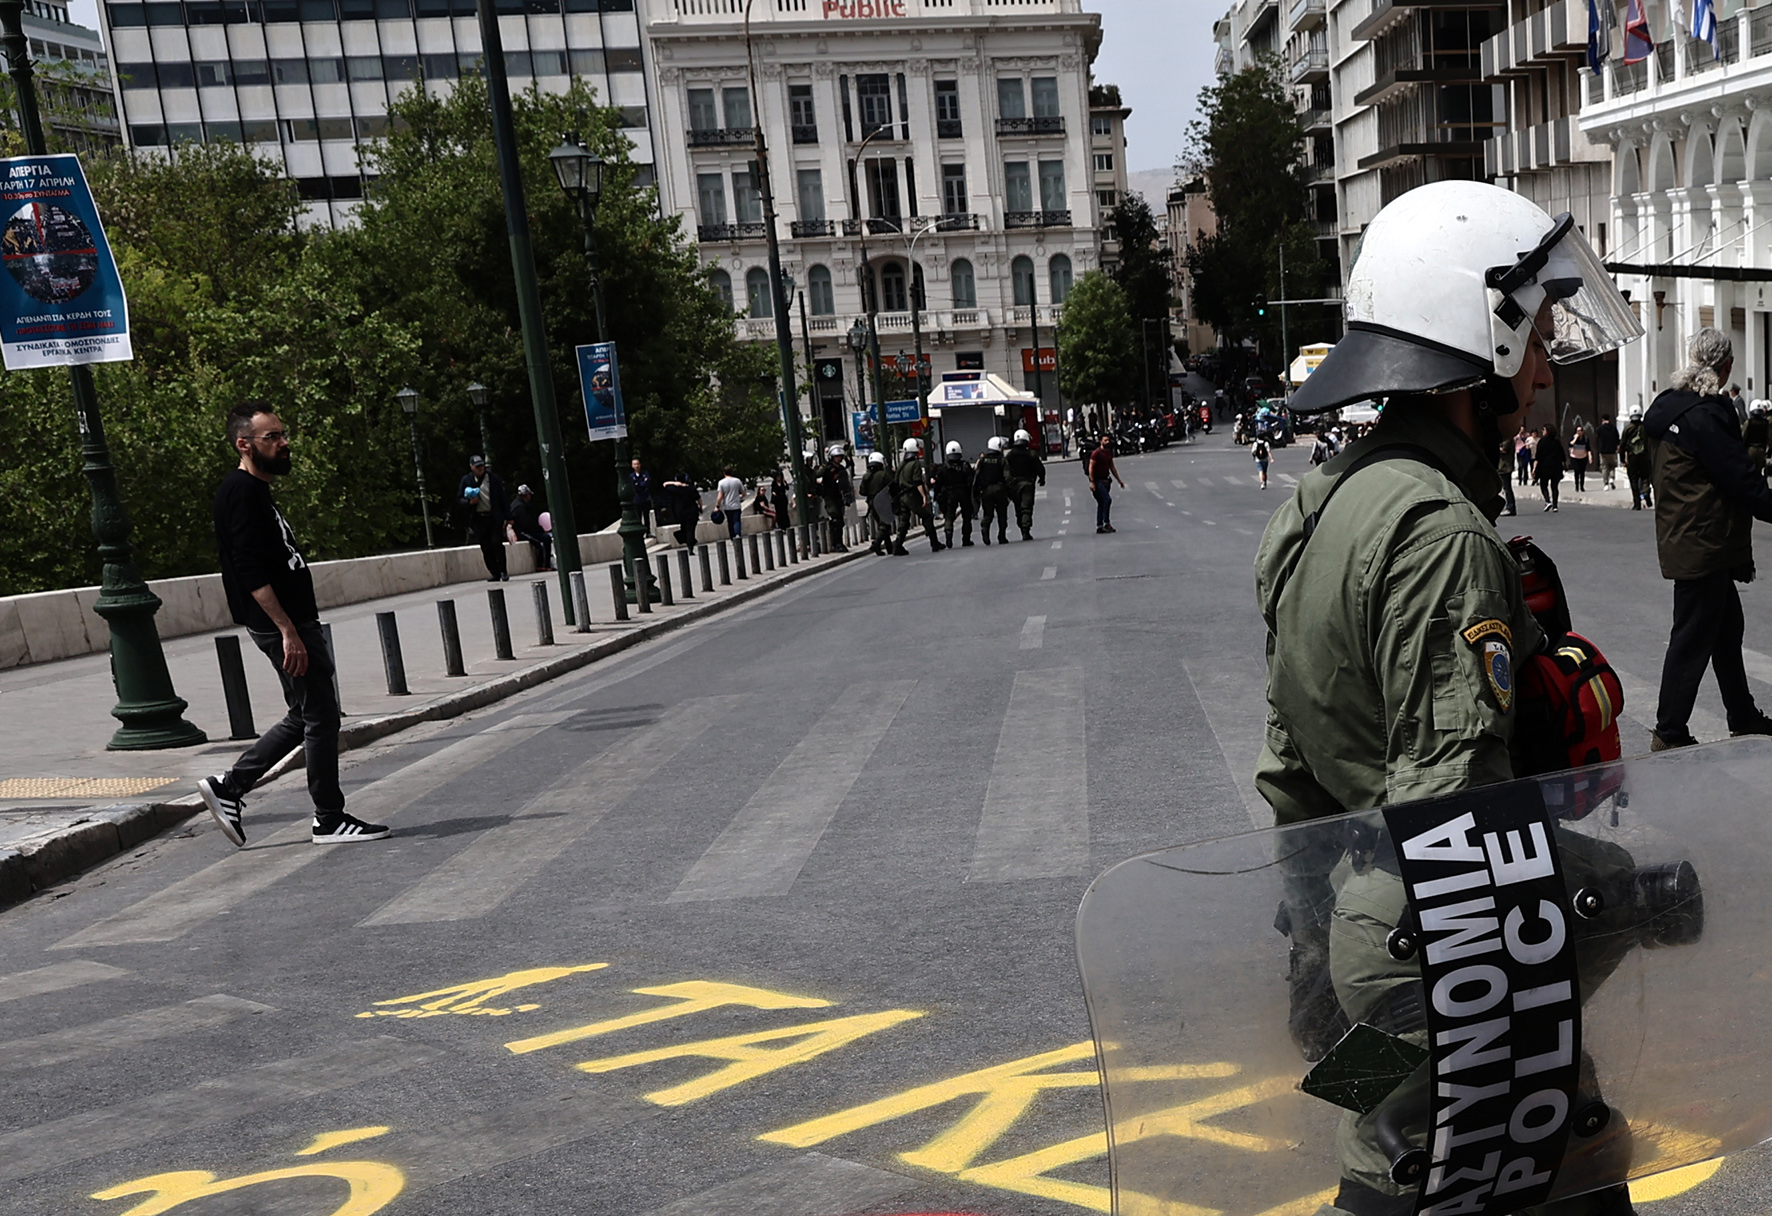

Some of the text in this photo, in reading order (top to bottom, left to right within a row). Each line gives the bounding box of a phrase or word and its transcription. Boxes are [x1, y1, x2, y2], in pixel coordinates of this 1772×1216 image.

[822, 0, 906, 19] Public
[9, 165, 52, 178] ΑΠΕΡΓΙΑ
[24, 179, 36, 189] 17
[40, 177, 75, 187] ΑΠΡΙΛΗ
[66, 312, 92, 320] ΚΕΡΔΗ
[93, 309, 112, 318] ΤΟΥΣ
[65, 337, 119, 348] ΟΜΟΣΠΟΝΔΙΕΣ
[74, 346, 103, 355] ΚΕΝΤΡΑ
[1483, 821, 1574, 1198] POLICE
[505, 979, 930, 1107] ΤΑ
